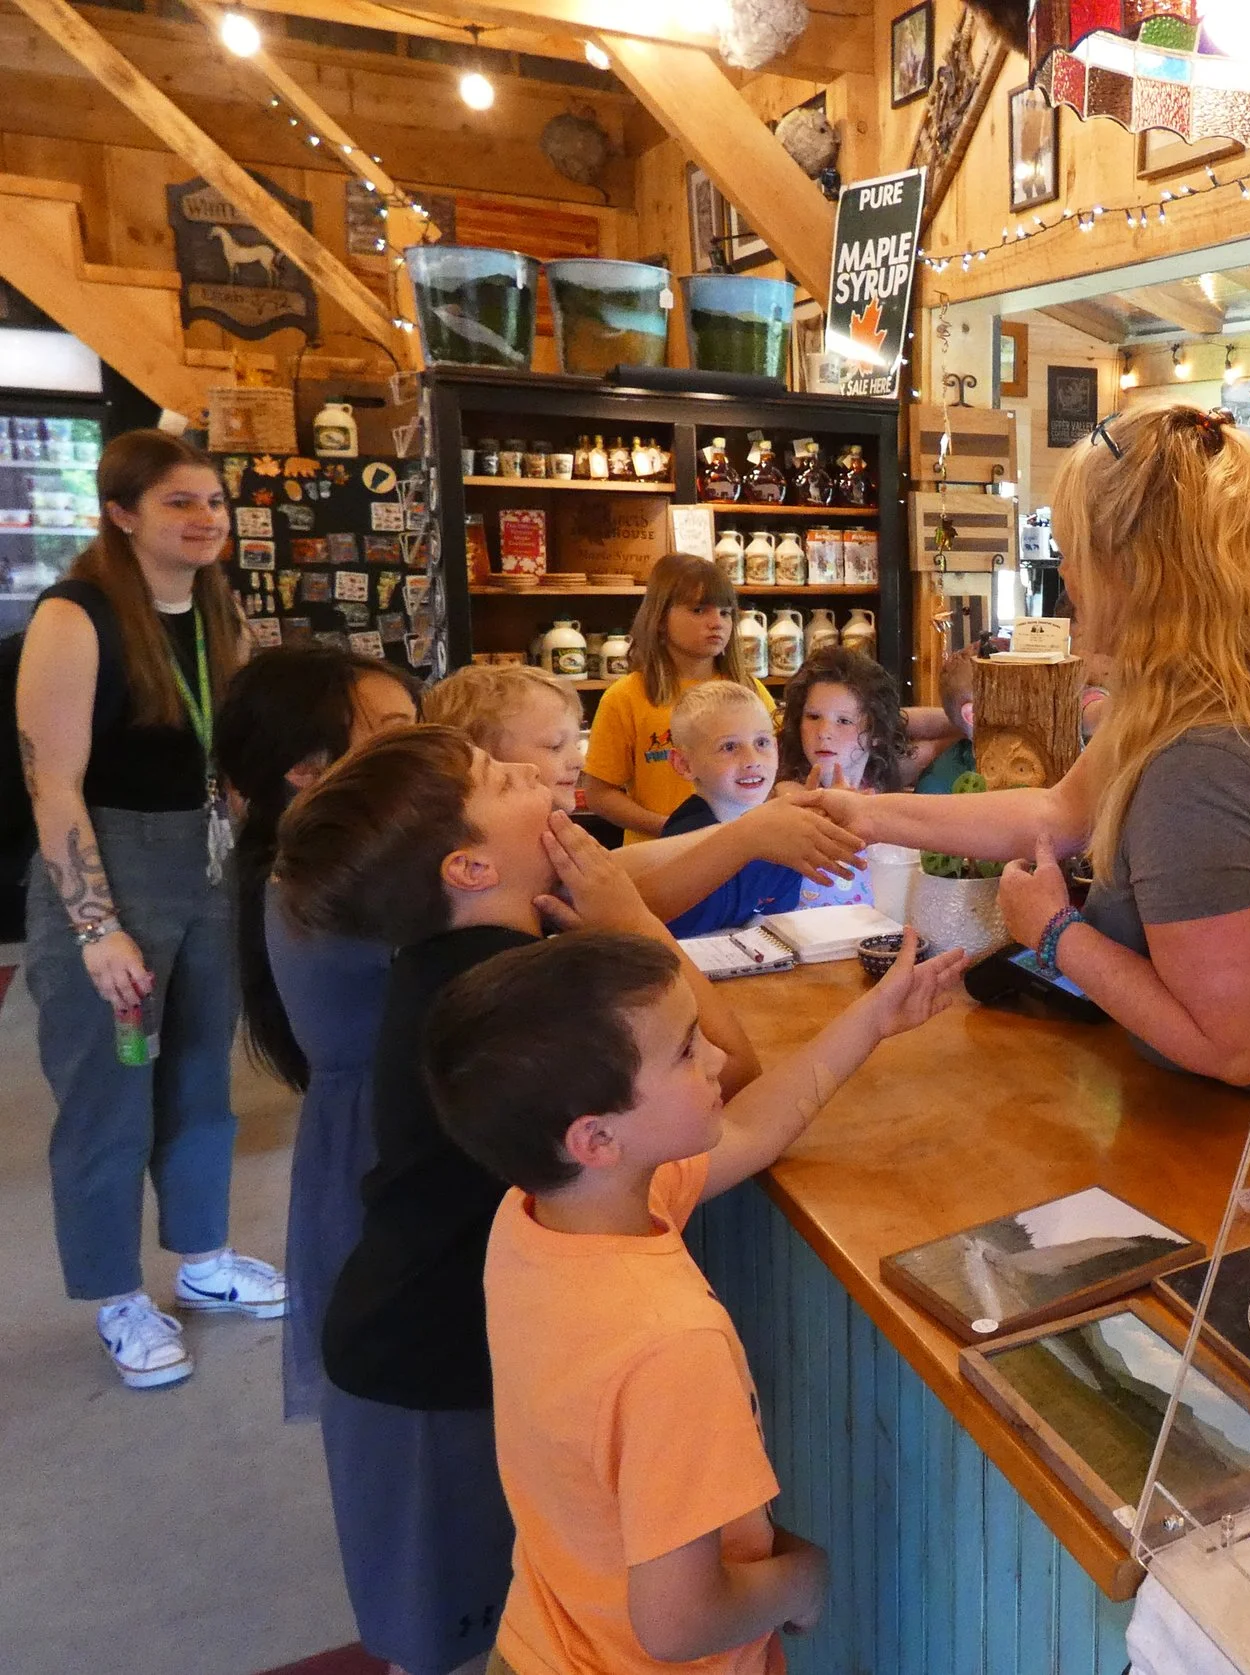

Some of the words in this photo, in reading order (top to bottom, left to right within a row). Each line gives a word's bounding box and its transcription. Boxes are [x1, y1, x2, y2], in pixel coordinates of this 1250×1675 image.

[859, 181, 904, 211] PURE
[837, 231, 912, 273] MAPLE
[835, 264, 909, 304] SYRUP
[847, 379, 867, 396] SALE
[870, 377, 891, 393] HERE
